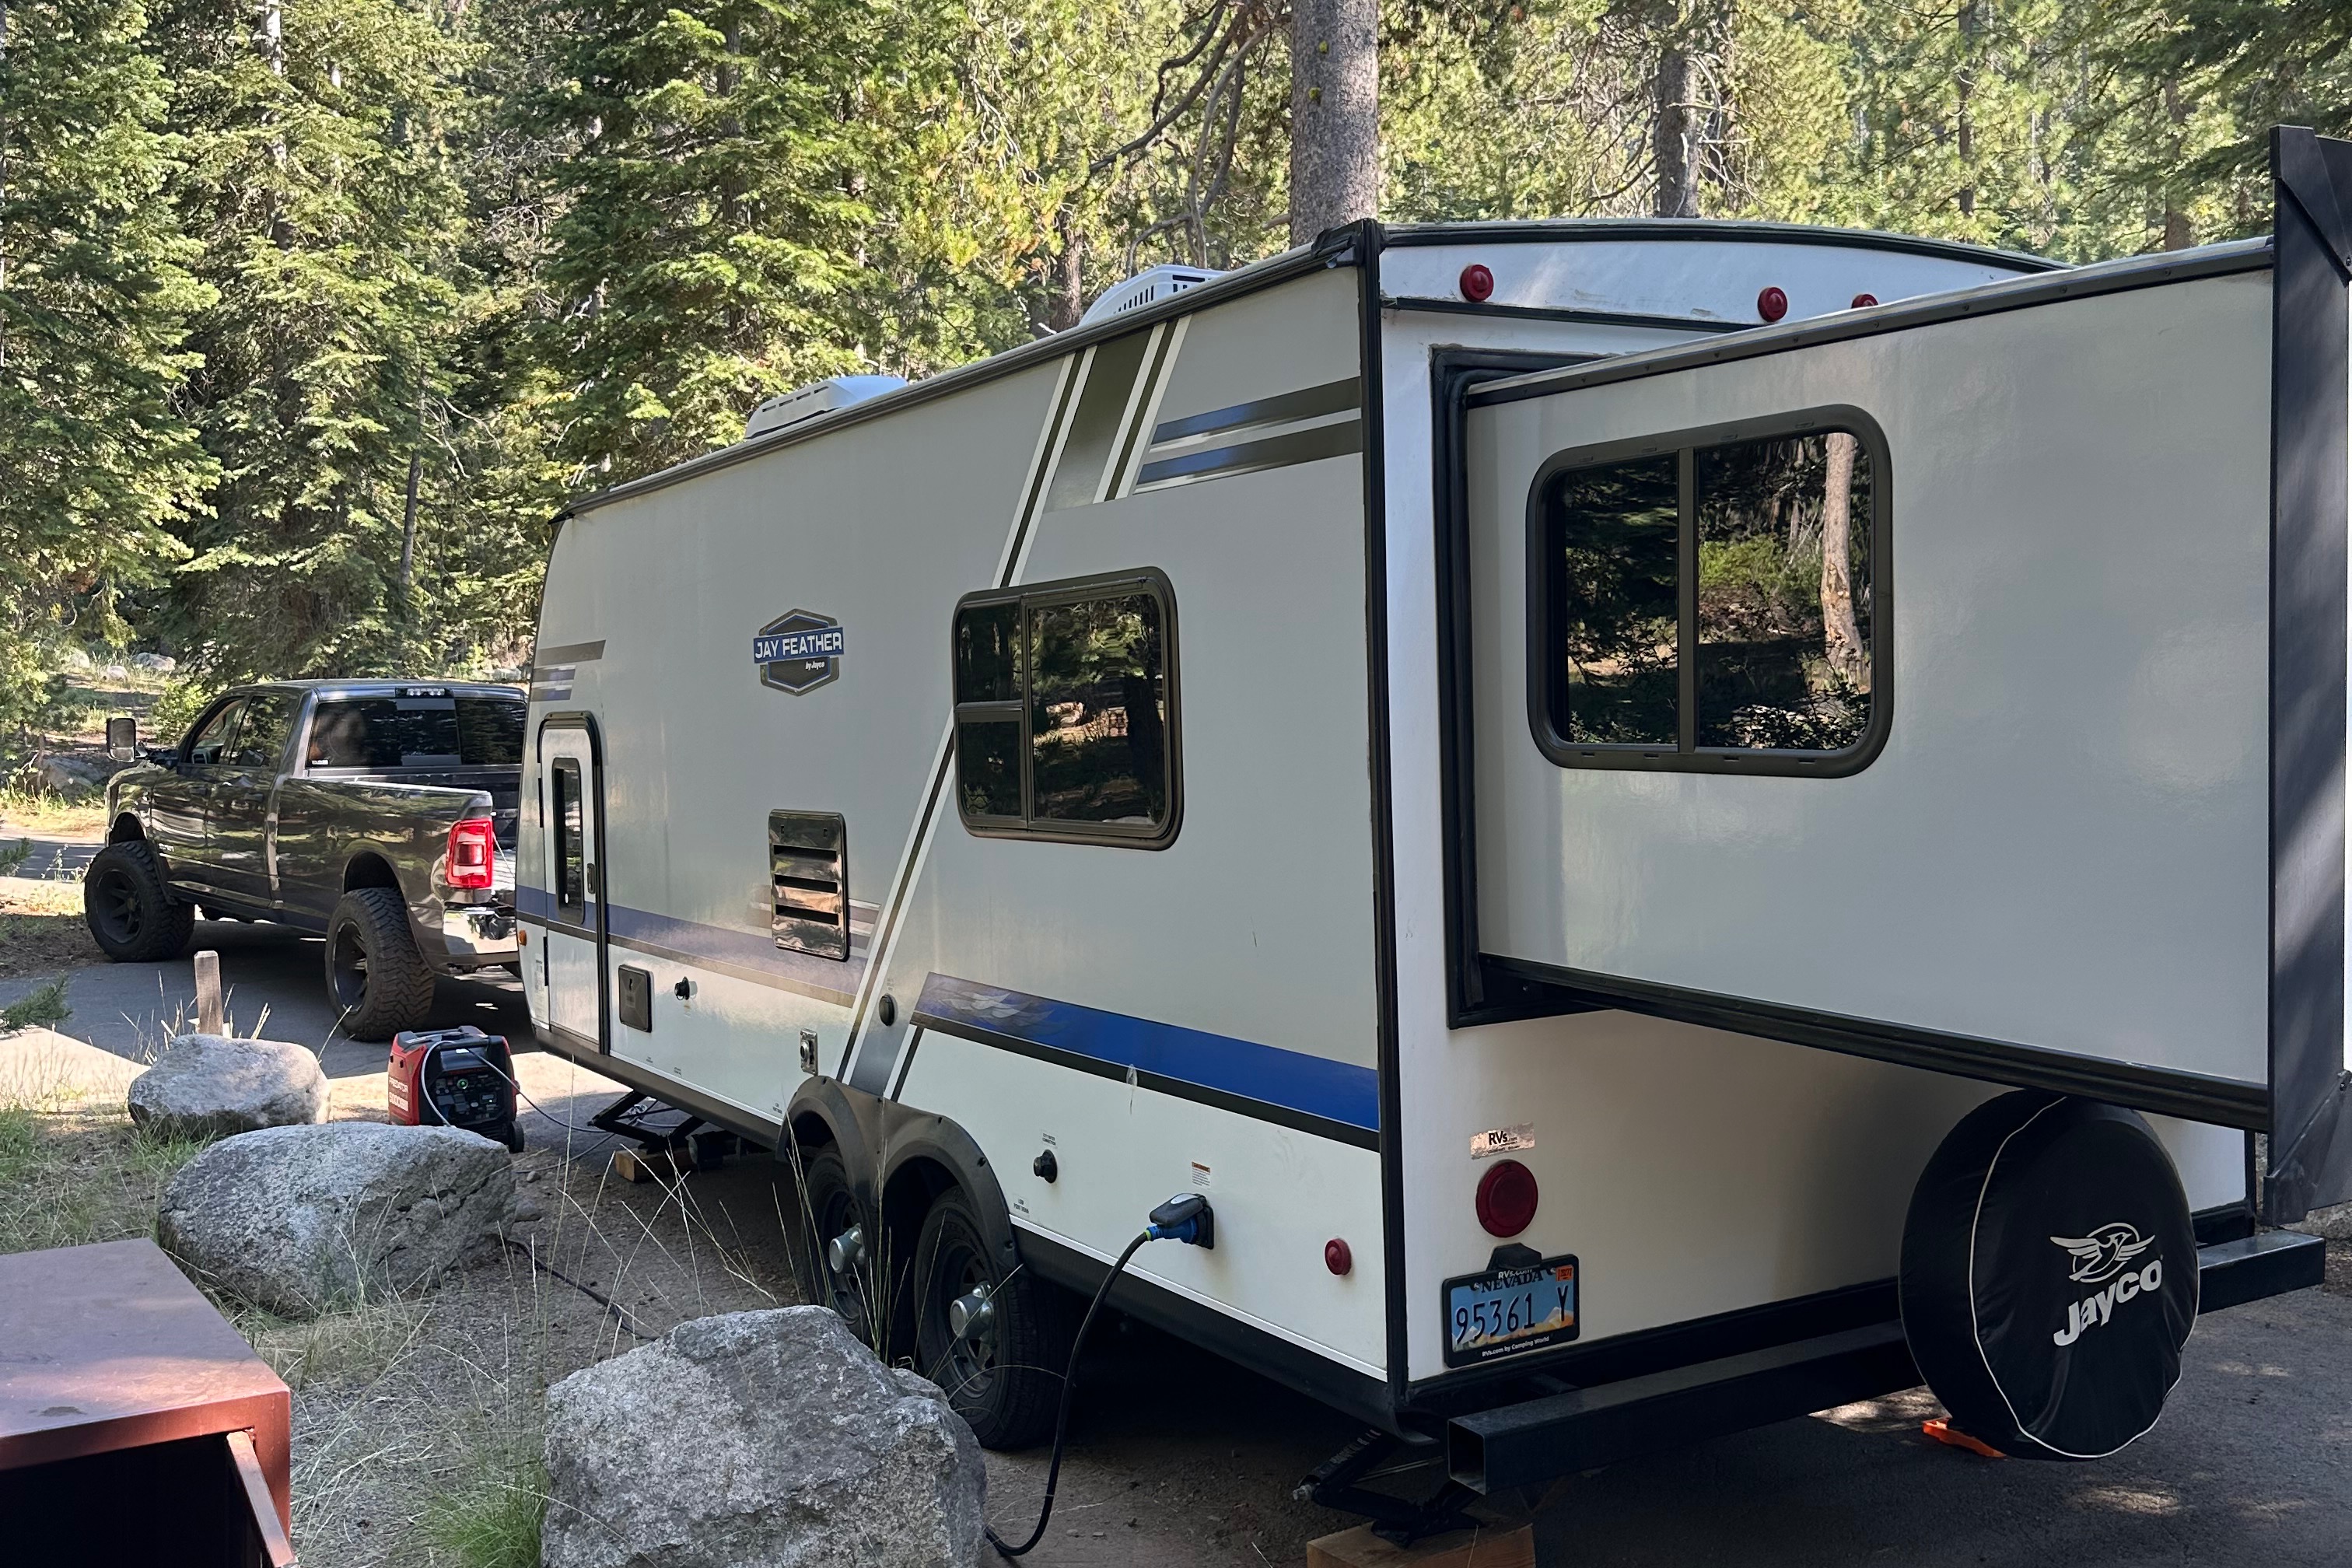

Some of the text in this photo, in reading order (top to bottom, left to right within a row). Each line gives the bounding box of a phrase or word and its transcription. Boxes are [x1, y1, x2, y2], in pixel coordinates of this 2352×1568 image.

[754, 632, 843, 659] JAY FEATHER
[805, 660, 825, 670] by Jayco
[1481, 1270, 1544, 1293] NEVADA
[1455, 1284, 1569, 1345] 95361 Y
[2053, 1259, 2163, 1347] Jayco
[1482, 1346, 1504, 1357] RVs.com
[1511, 1339, 1534, 1350] Camping
[1534, 1335, 1549, 1345] World
